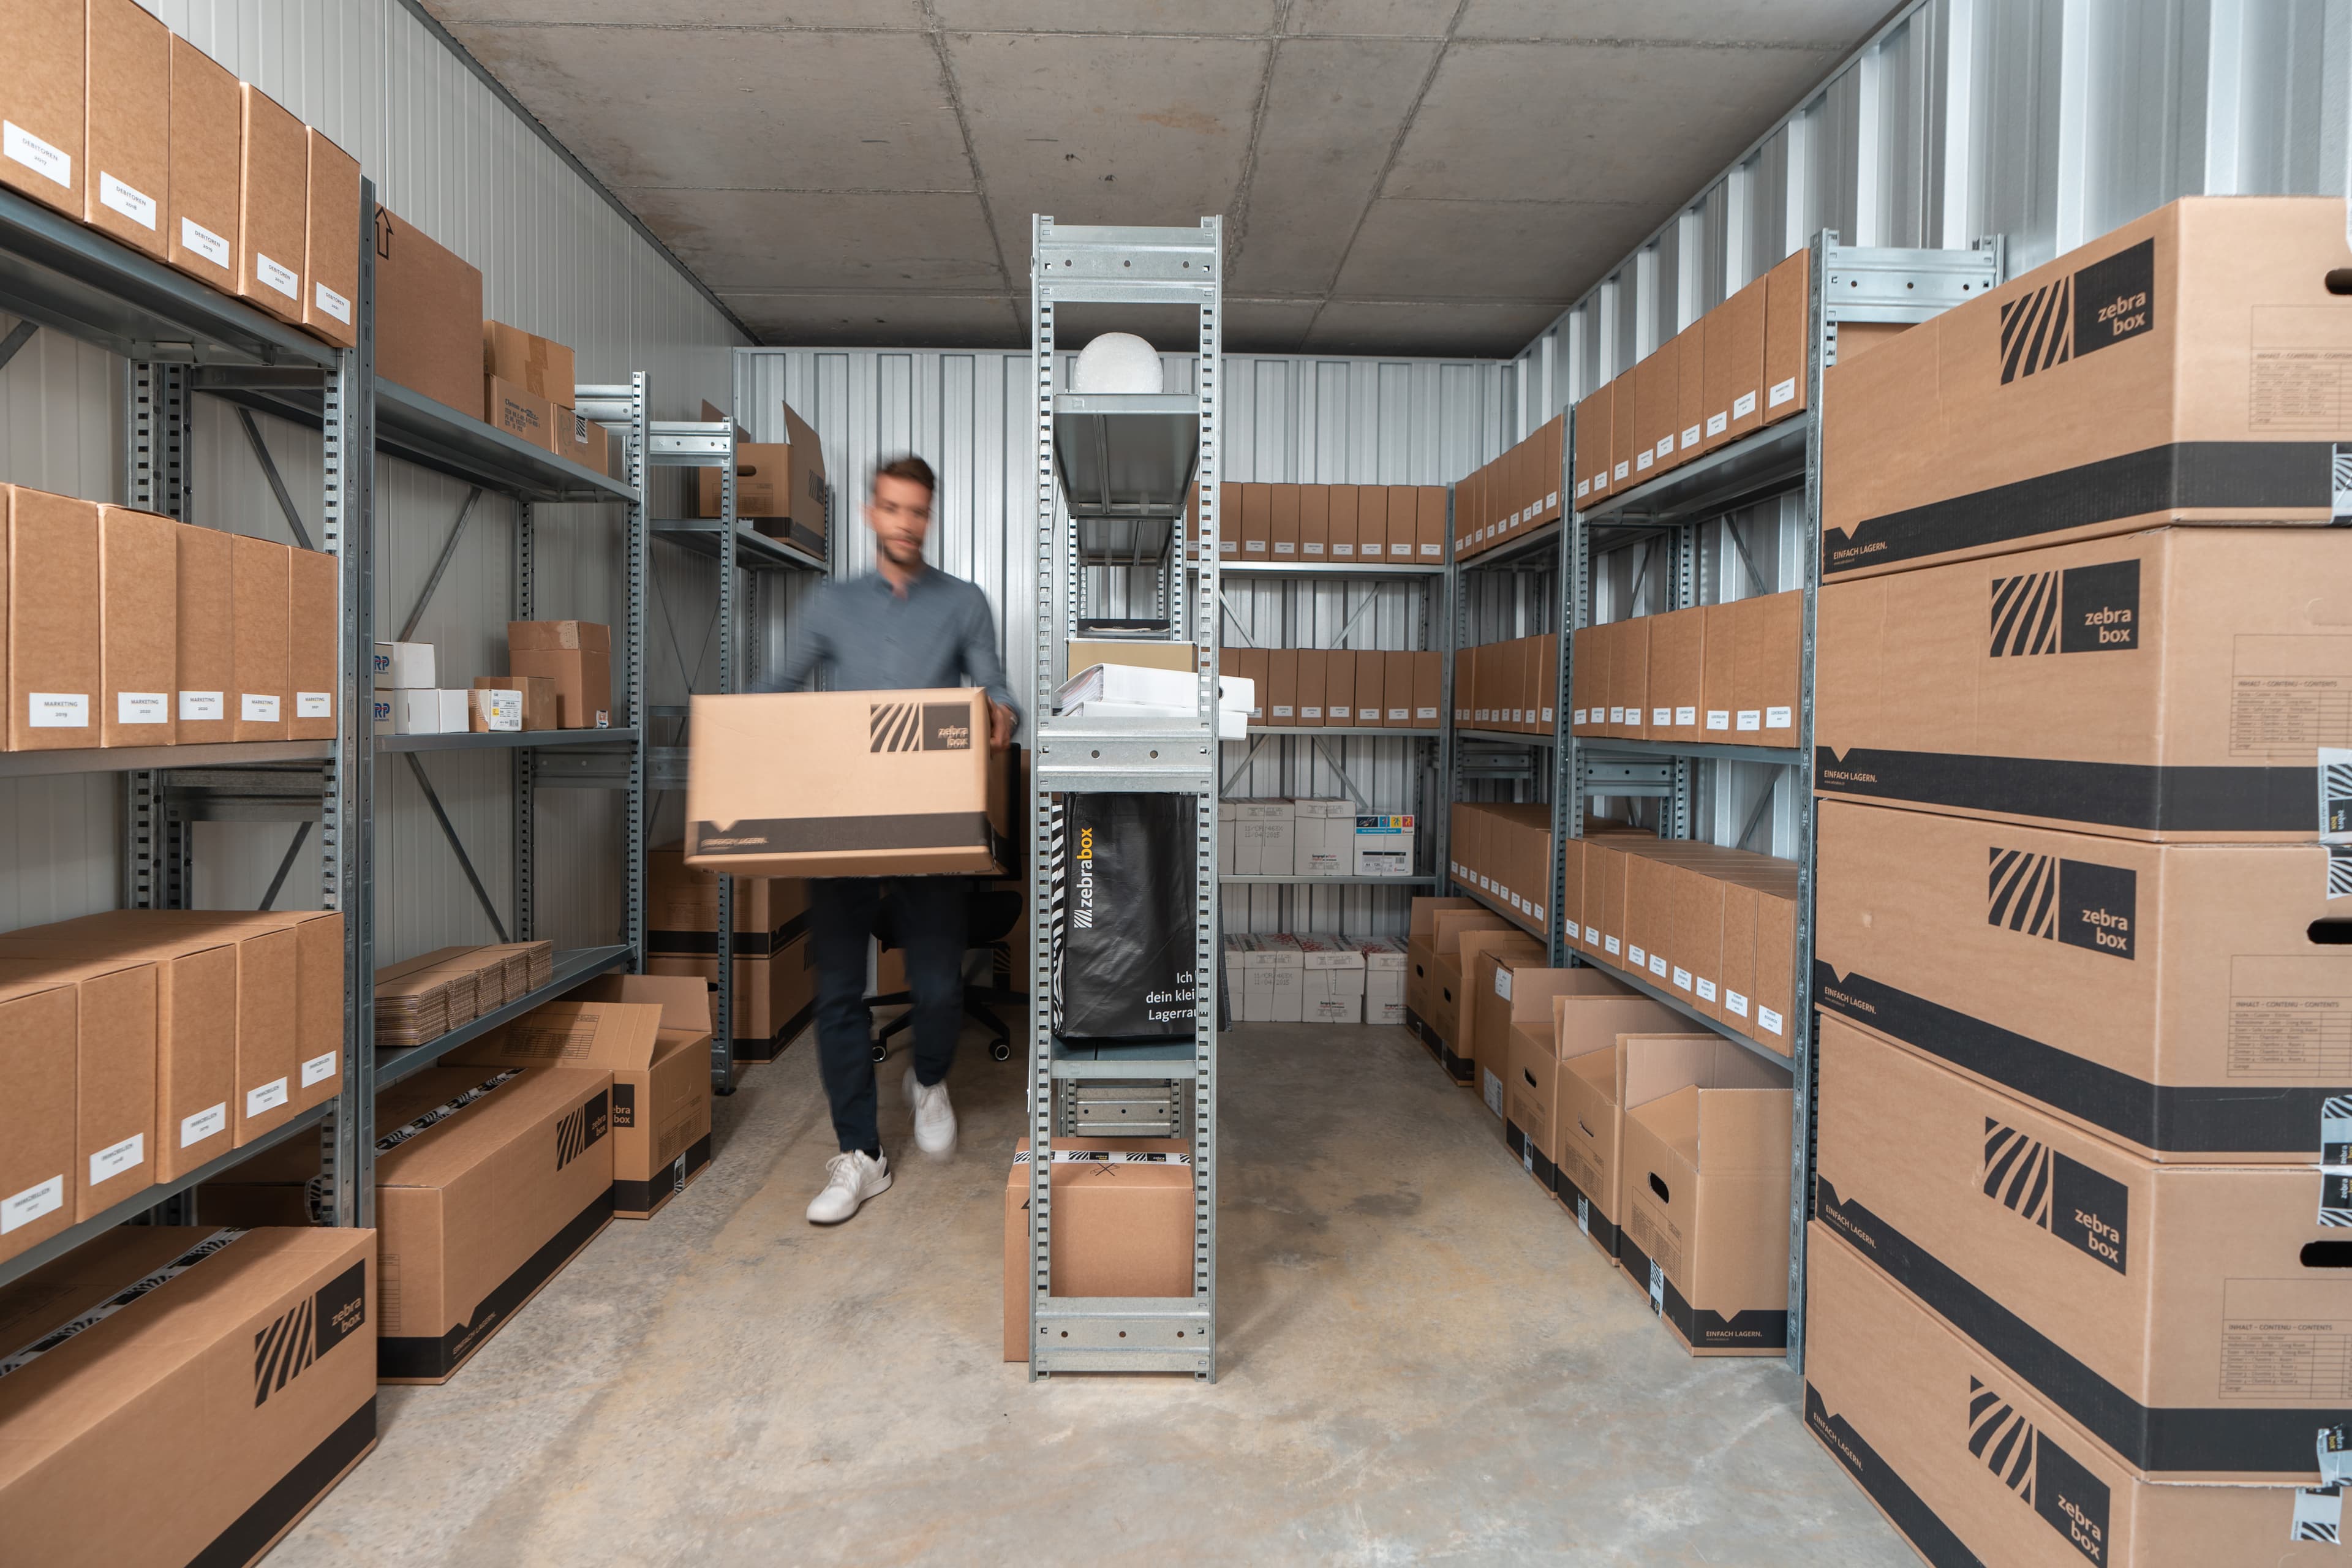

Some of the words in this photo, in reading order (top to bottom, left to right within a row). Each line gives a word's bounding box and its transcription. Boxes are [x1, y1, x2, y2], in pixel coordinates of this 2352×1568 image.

[22, 137, 58, 161] DEBITOREN
[34, 156, 47, 165] 2017
[116, 186, 146, 206] DEBITOREN
[126, 202, 137, 211] 2018
[195, 230, 221, 247] DEBITOREN
[269, 265, 290, 280] DEBITOREN
[326, 292, 345, 306] DEBITOREN
[2098, 291, 2146, 323] zebra
[2113, 315, 2146, 336] box
[1833, 544, 1858, 560] EINFACH
[1860, 541, 1888, 556] LAGERN.
[2085, 607, 2132, 625] zebra
[2099, 627, 2130, 643] box
[937, 725, 969, 739] zebra
[946, 737, 968, 748] box
[1823, 769, 1849, 781] EINFACH
[1850, 772, 1877, 783] LAGERN.
[1076, 827, 1093, 909] zebrabox
[2082, 908, 2128, 932] zebra
[2097, 927, 2127, 951] box
[1177, 971, 1193, 984] Ich
[1146, 991, 1172, 1003] dein
[1175, 989, 1196, 1001] klei
[1824, 986, 1849, 1003] EINFACH
[1850, 996, 1877, 1015] LAGERN.
[1148, 1009, 1197, 1022] Lagerra
[612, 1105, 630, 1114] ebra
[614, 1114, 630, 1123] box
[592, 1114, 606, 1130] zebra
[596, 1125, 606, 1136] box
[1825, 1204, 1850, 1230] EINFACH
[1850, 1223, 1877, 1249] LAGERN.
[2075, 1208, 2120, 1244] zebra
[2088, 1231, 2119, 1264] box
[331, 1297, 362, 1327] zebra
[341, 1311, 362, 1333] box
[1814, 1412, 1837, 1442] EINFACH
[1838, 1438, 1863, 1471] LAGERN.
[2057, 1494, 2101, 1542] zebra
[2071, 1520, 2100, 1561] box
